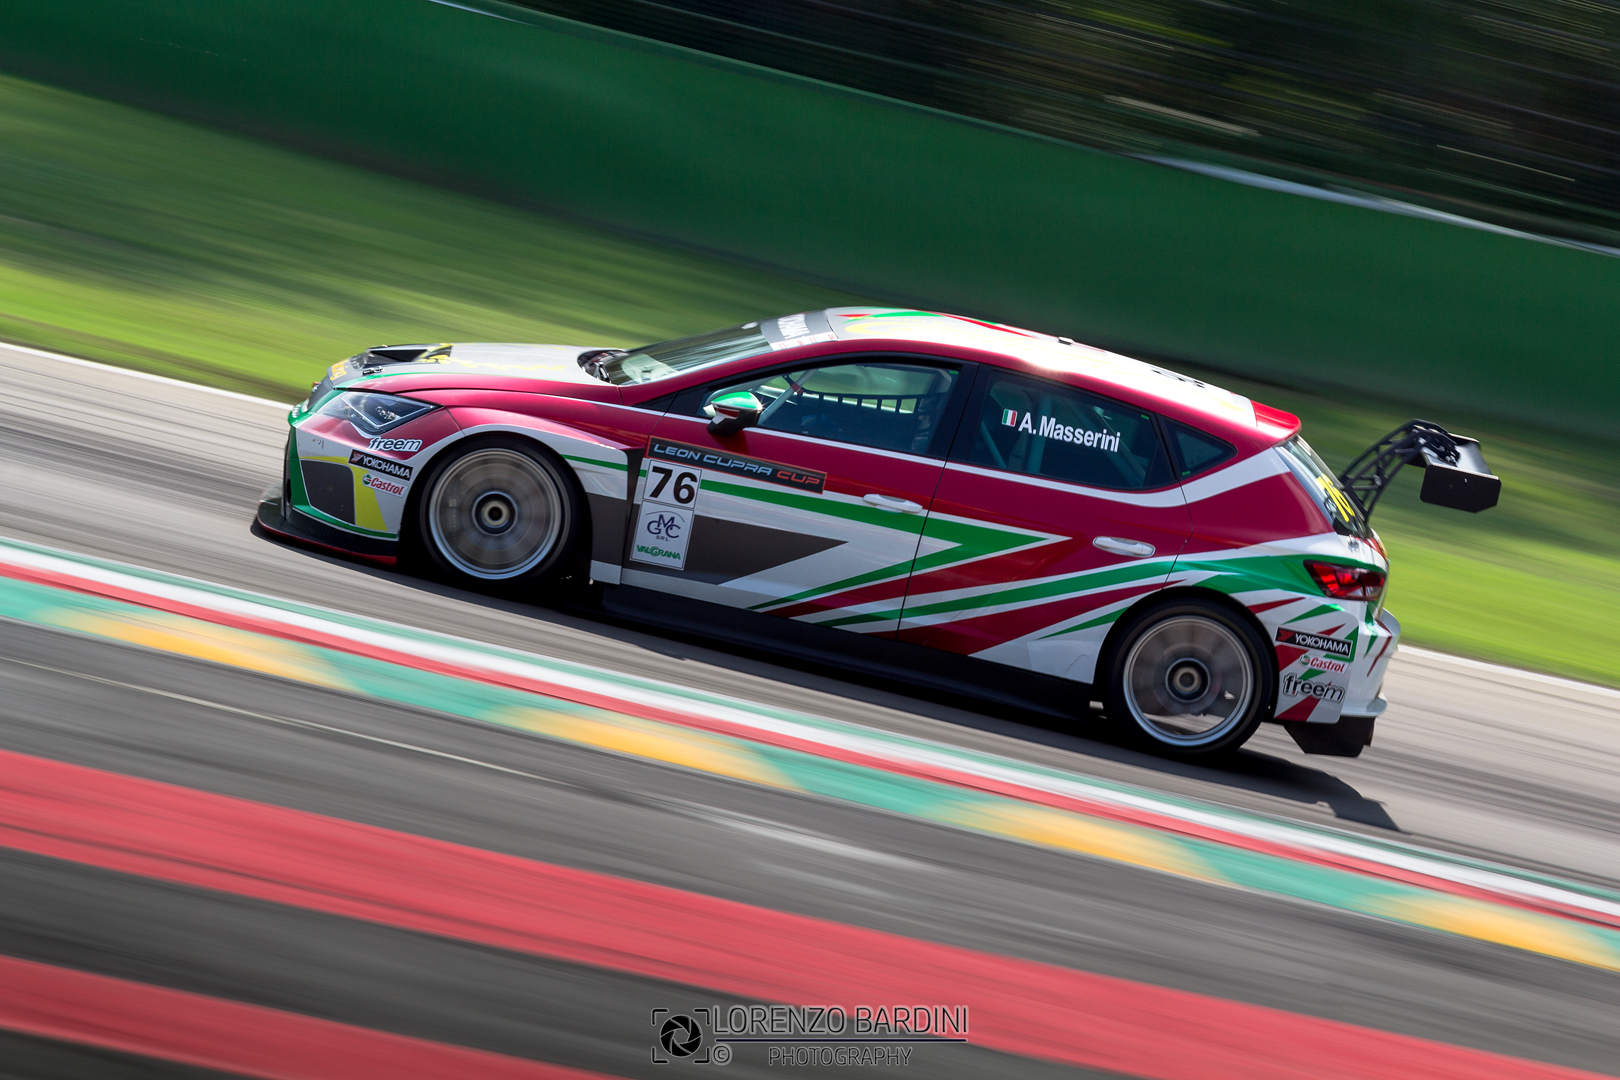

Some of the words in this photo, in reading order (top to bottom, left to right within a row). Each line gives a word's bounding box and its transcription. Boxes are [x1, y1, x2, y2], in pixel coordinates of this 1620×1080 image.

[369, 437, 421, 452] freem
[362, 455, 410, 479] YOKOHAMA
[653, 444, 701, 460] LEON
[703, 454, 773, 476] CUPRA
[776, 470, 821, 485] CUP
[371, 477, 405, 495] Castrol
[649, 465, 698, 504] 76
[636, 544, 681, 560] VALGRANA
[1295, 633, 1350, 657] YOKOHAMA
[1310, 656, 1345, 673] Castrol
[1285, 675, 1344, 702] freem
